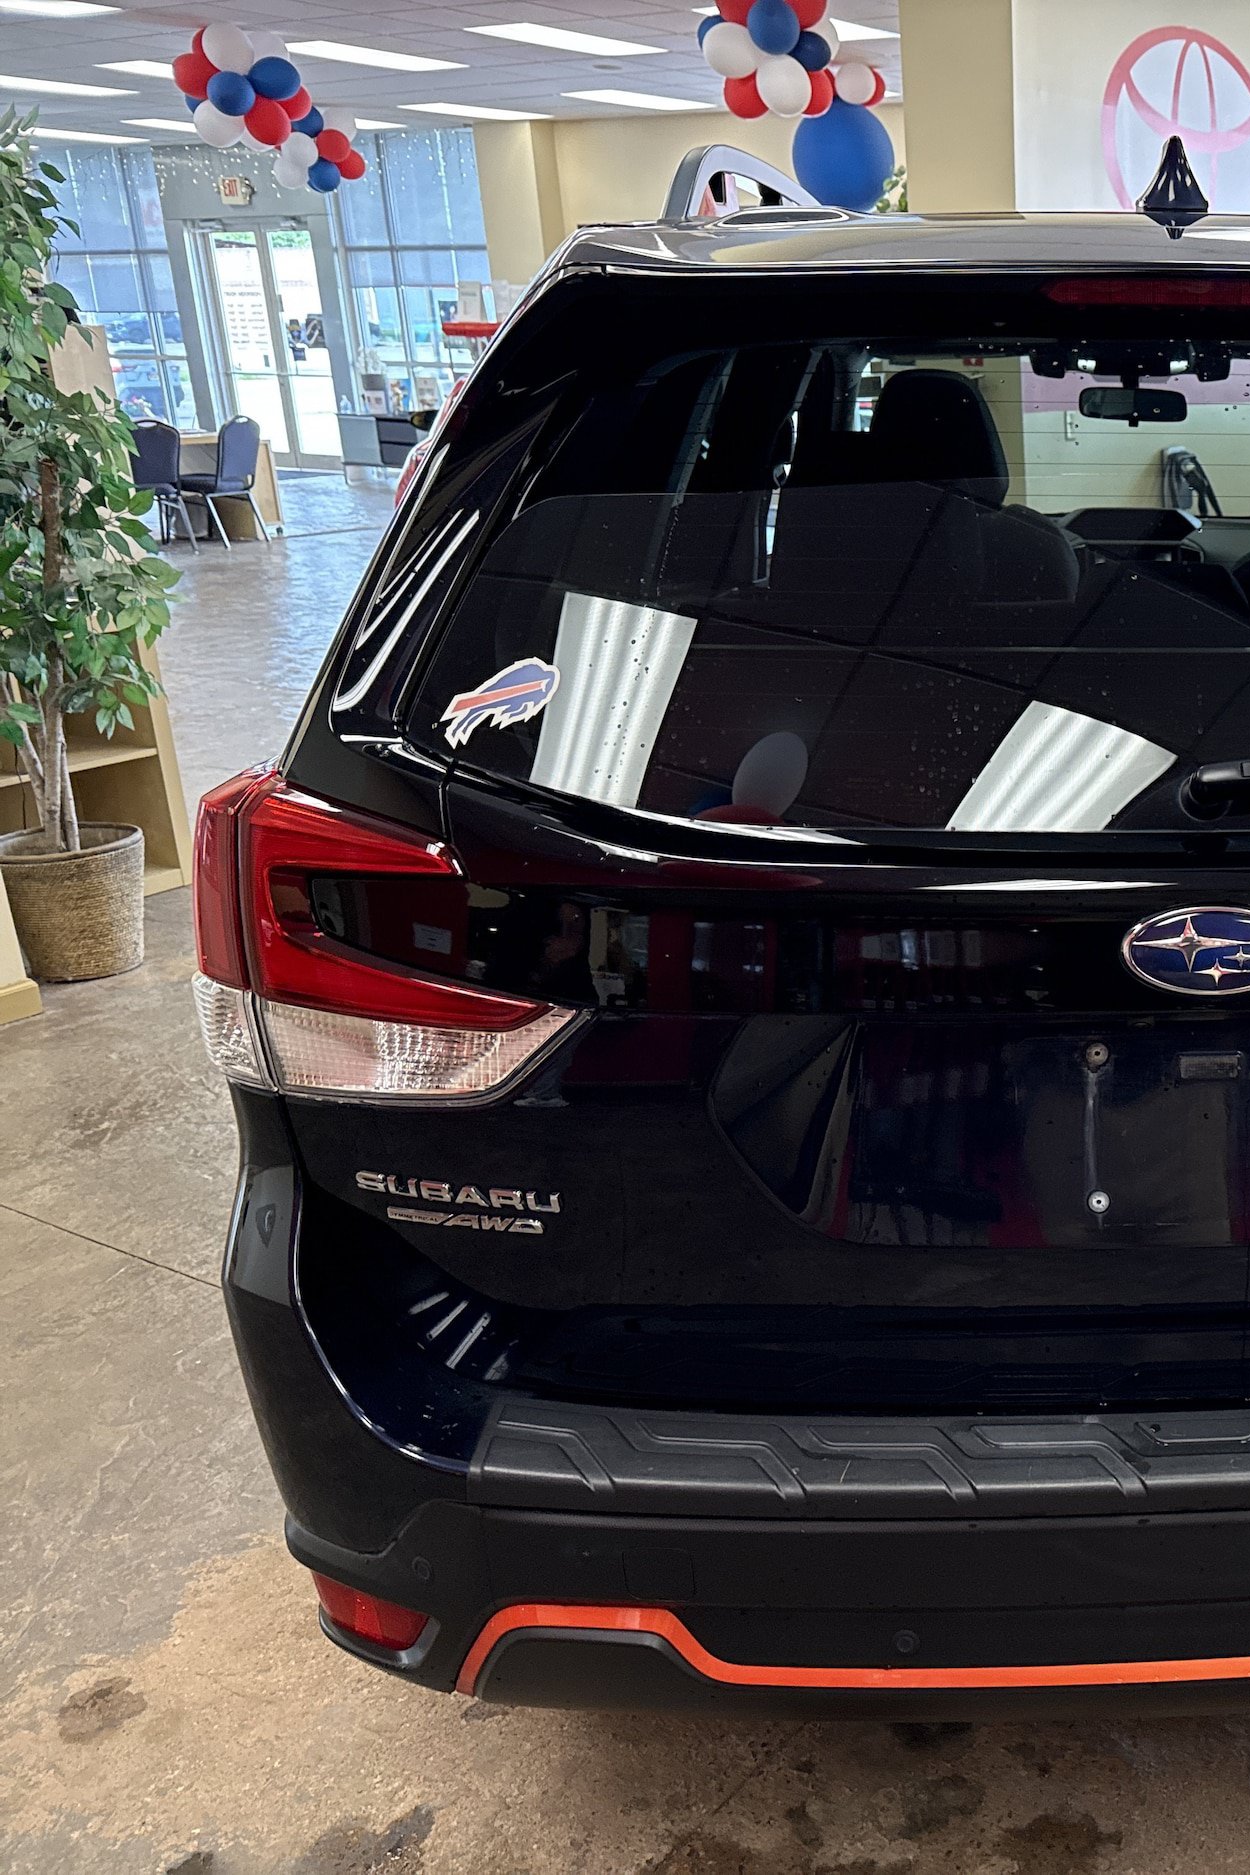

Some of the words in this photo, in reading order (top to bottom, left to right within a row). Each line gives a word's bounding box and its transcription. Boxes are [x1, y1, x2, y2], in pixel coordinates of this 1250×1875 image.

[222, 178, 239, 197] EXIT
[355, 1171, 561, 1213] SUBARU
[444, 1213, 544, 1234] AWD
